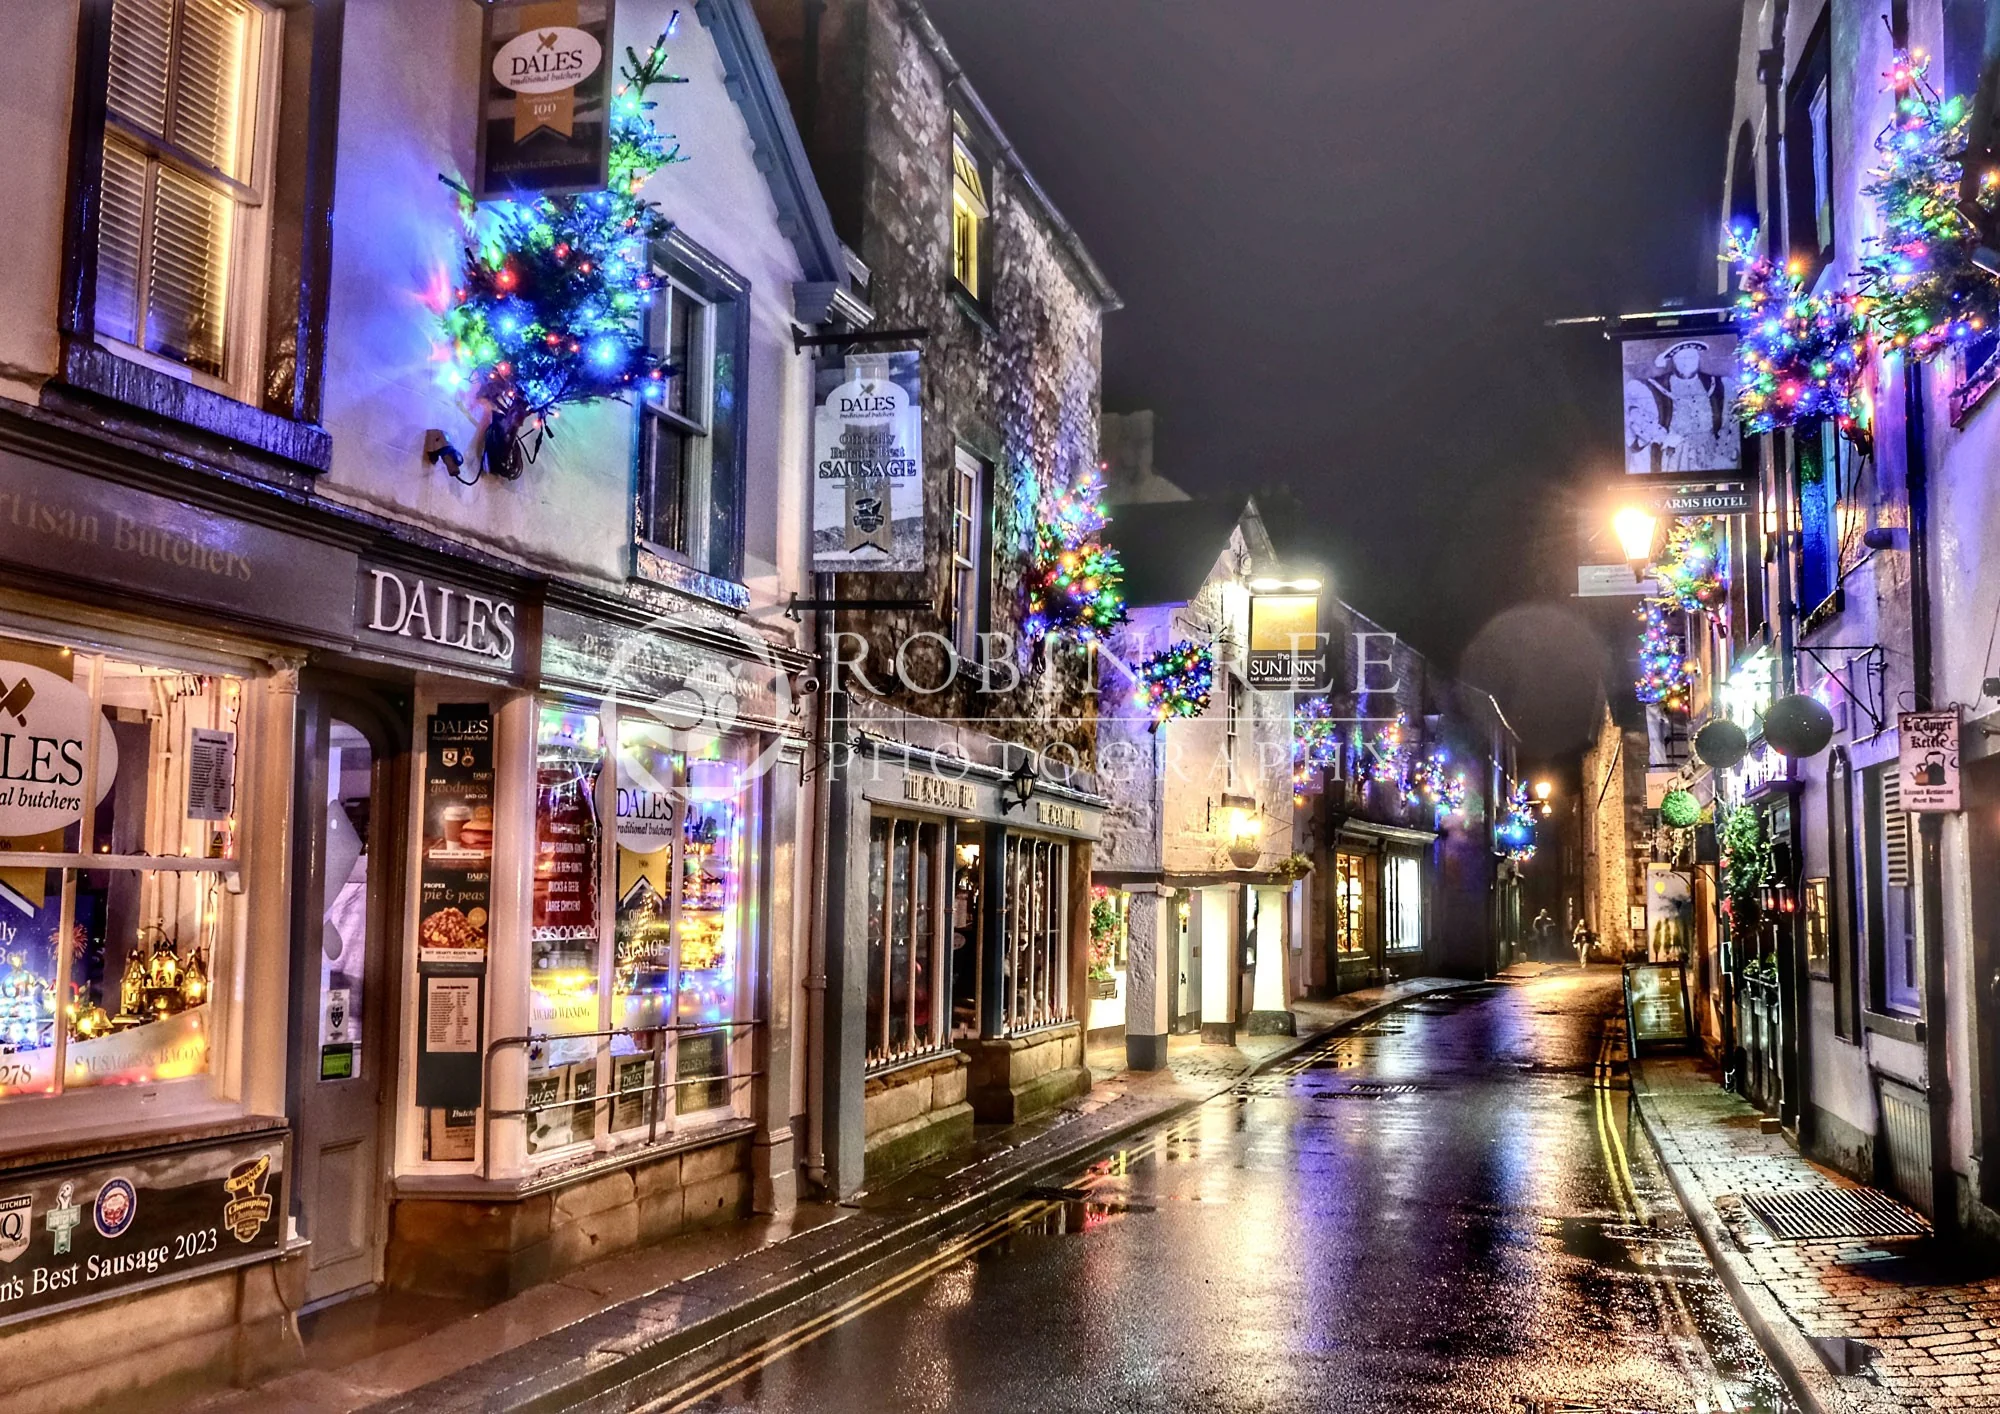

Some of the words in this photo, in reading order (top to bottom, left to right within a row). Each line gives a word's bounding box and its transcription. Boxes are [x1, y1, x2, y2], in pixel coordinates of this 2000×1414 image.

[511, 49, 583, 76] DALES
[510, 74, 549, 86] traditional
[551, 71, 582, 81] butchers
[533, 104, 556, 115] 100
[840, 396, 896, 412] DALES
[839, 432, 896, 446] Officially
[878, 446, 905, 457] Best
[819, 459, 917, 479] SAUSAGE
[1664, 498, 1700, 509] ARMS
[1703, 496, 1748, 507] HOTEL
[112, 515, 251, 581] Butchers
[368, 569, 515, 661] DALES
[1251, 660, 1282, 675] SUN
[1287, 660, 1316, 675] INN
[433, 720, 489, 734] DALES
[431, 781, 487, 797] goodness
[18, 788, 81, 811] butchers
[616, 788, 673, 821] DALES
[617, 821, 648, 834] raditional
[648, 823, 673, 836] butchers
[424, 890, 442, 903] pie
[445, 889, 454, 900] &
[458, 891, 485, 904] peas
[532, 1008, 558, 1021] AWARD
[558, 1006, 590, 1019] WINNING
[74, 1053, 144, 1074] SAUSAGES
[160, 1047, 202, 1064] BACON
[0, 1063, 32, 1085] 278
[452, 1109, 476, 1118] Butch
[235, 1164, 262, 1187] WINNER
[0, 1198, 31, 1211] UTCHERS
[229, 1198, 269, 1215] Champion
[2, 1212, 23, 1242] Q
[0, 1275, 24, 1303] n's
[32, 1263, 81, 1295] Best
[86, 1242, 169, 1282] Sausage
[175, 1228, 218, 1261] 2023
